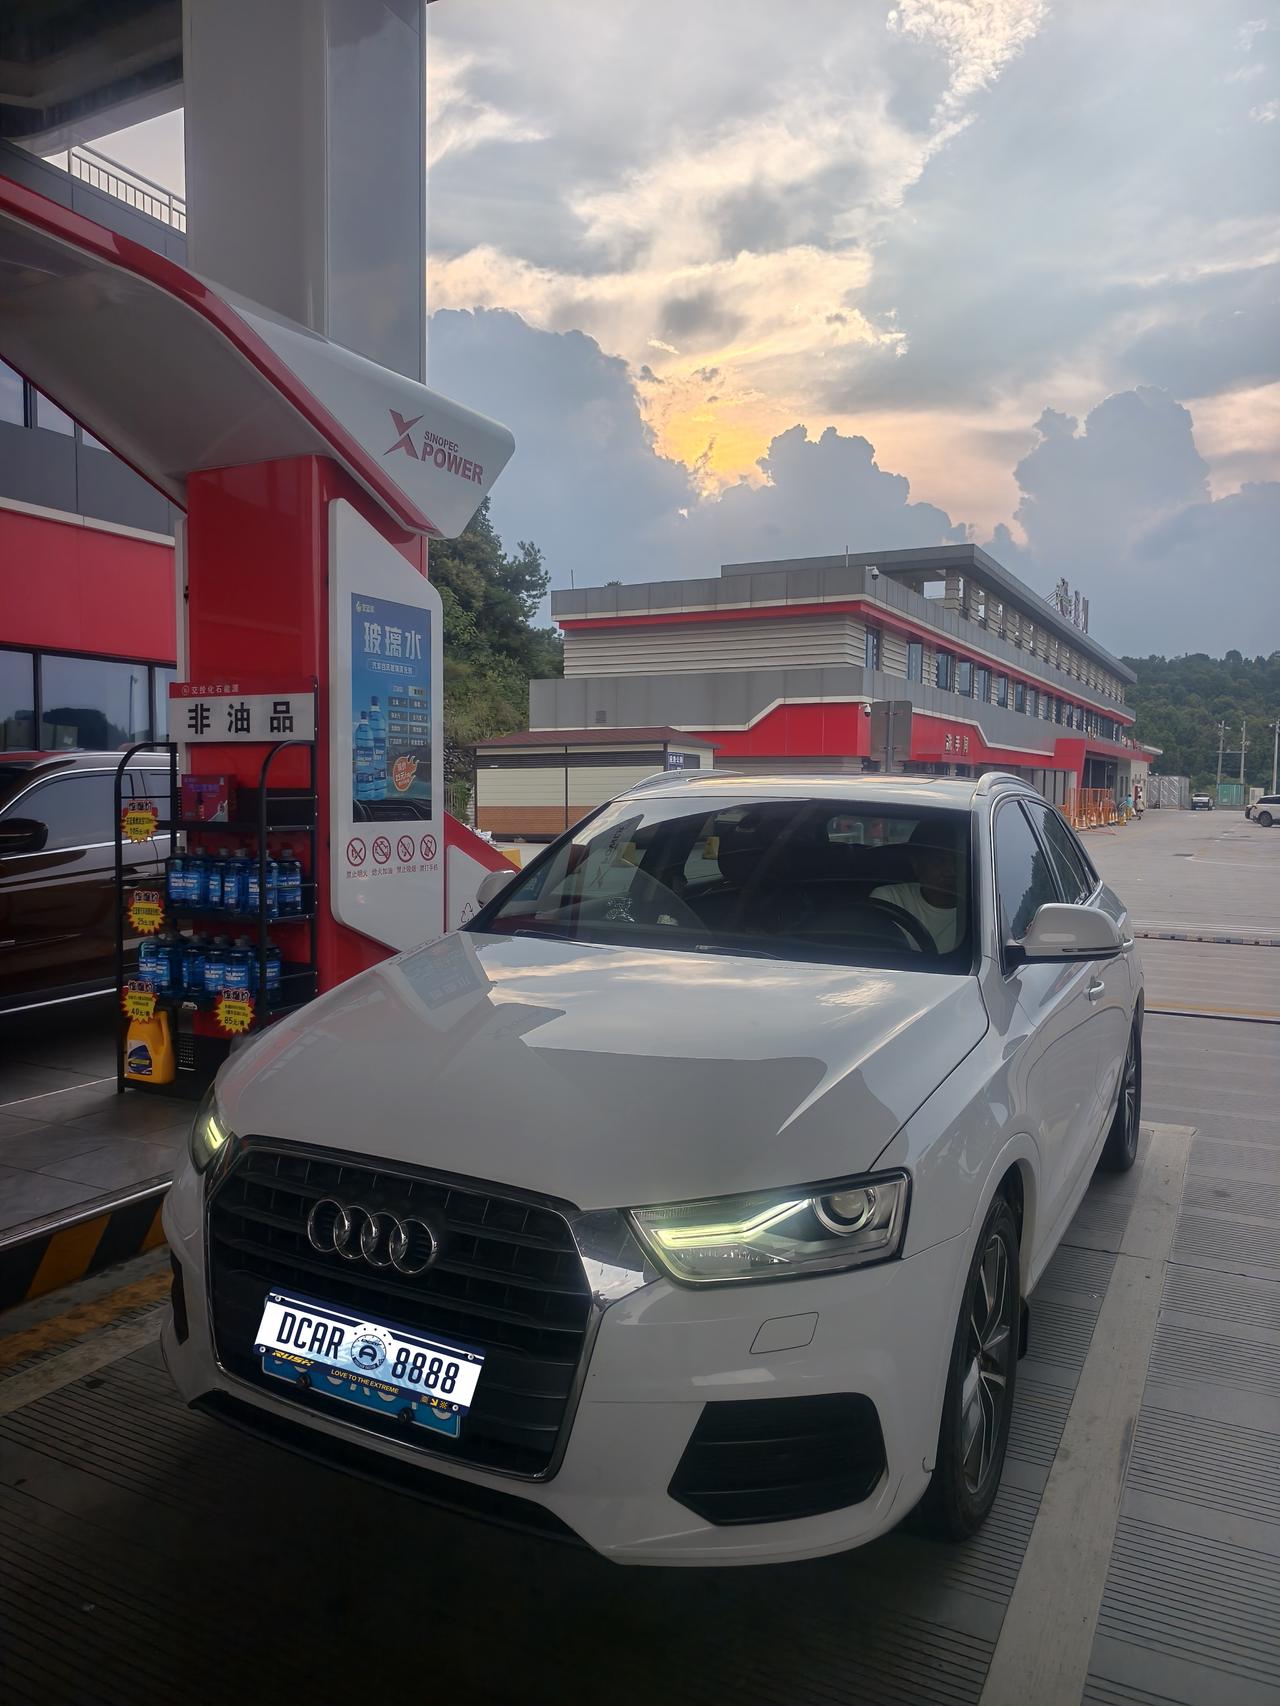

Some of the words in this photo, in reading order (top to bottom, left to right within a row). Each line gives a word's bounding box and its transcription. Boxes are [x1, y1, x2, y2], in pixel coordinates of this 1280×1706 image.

[424, 430, 459, 453] SINOPEC
[421, 441, 484, 485] POWER
[363, 621, 422, 660] 玻璃水
[187, 701, 294, 735] 非油品
